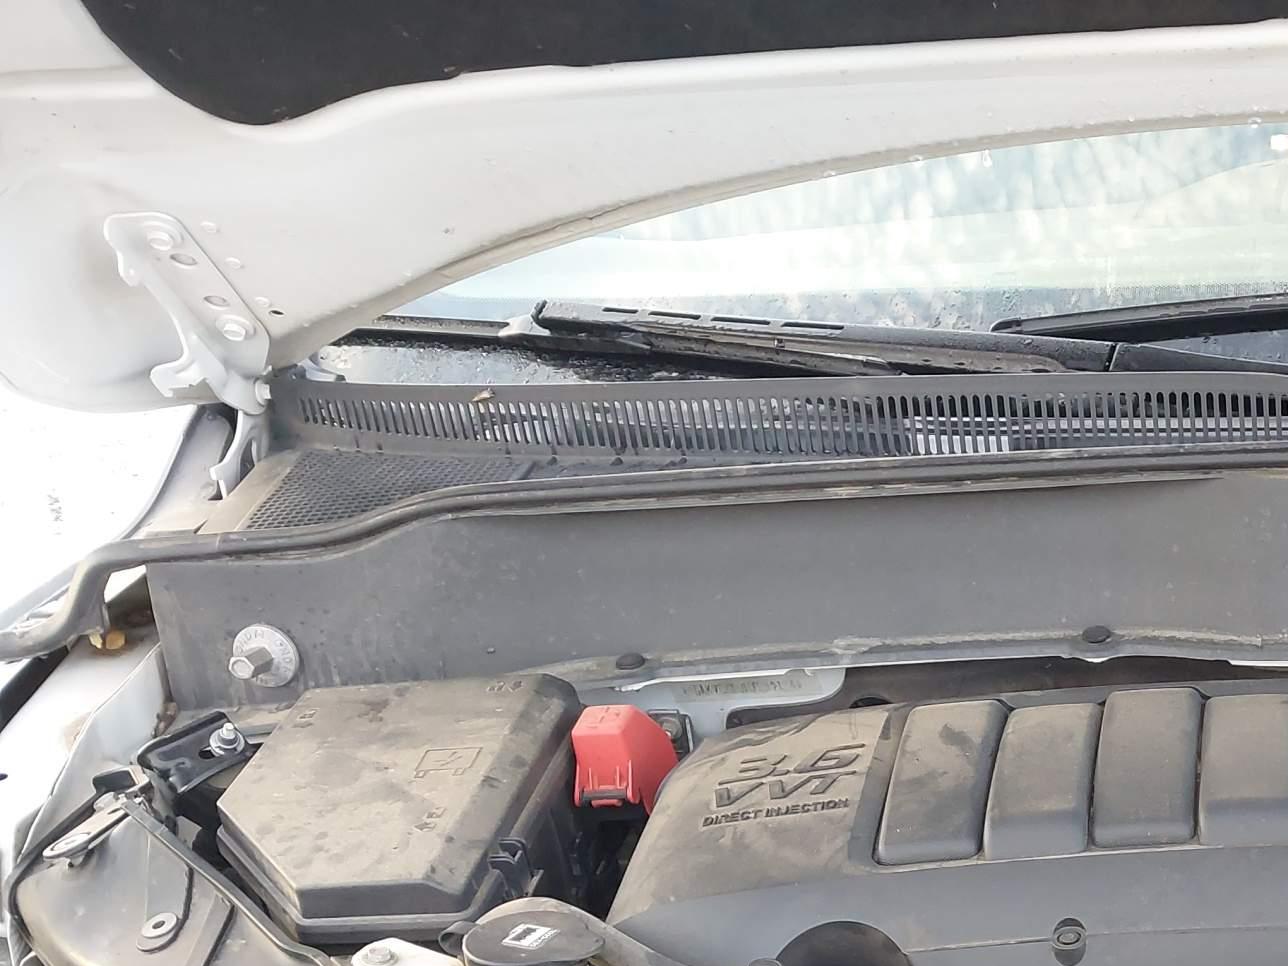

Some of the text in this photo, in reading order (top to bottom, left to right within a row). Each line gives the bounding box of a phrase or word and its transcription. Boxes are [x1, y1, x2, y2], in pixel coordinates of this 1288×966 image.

[718, 743, 866, 786] 3.6
[715, 770, 857, 808] VVT
[702, 798, 849, 827] DIRECT INJECTION
